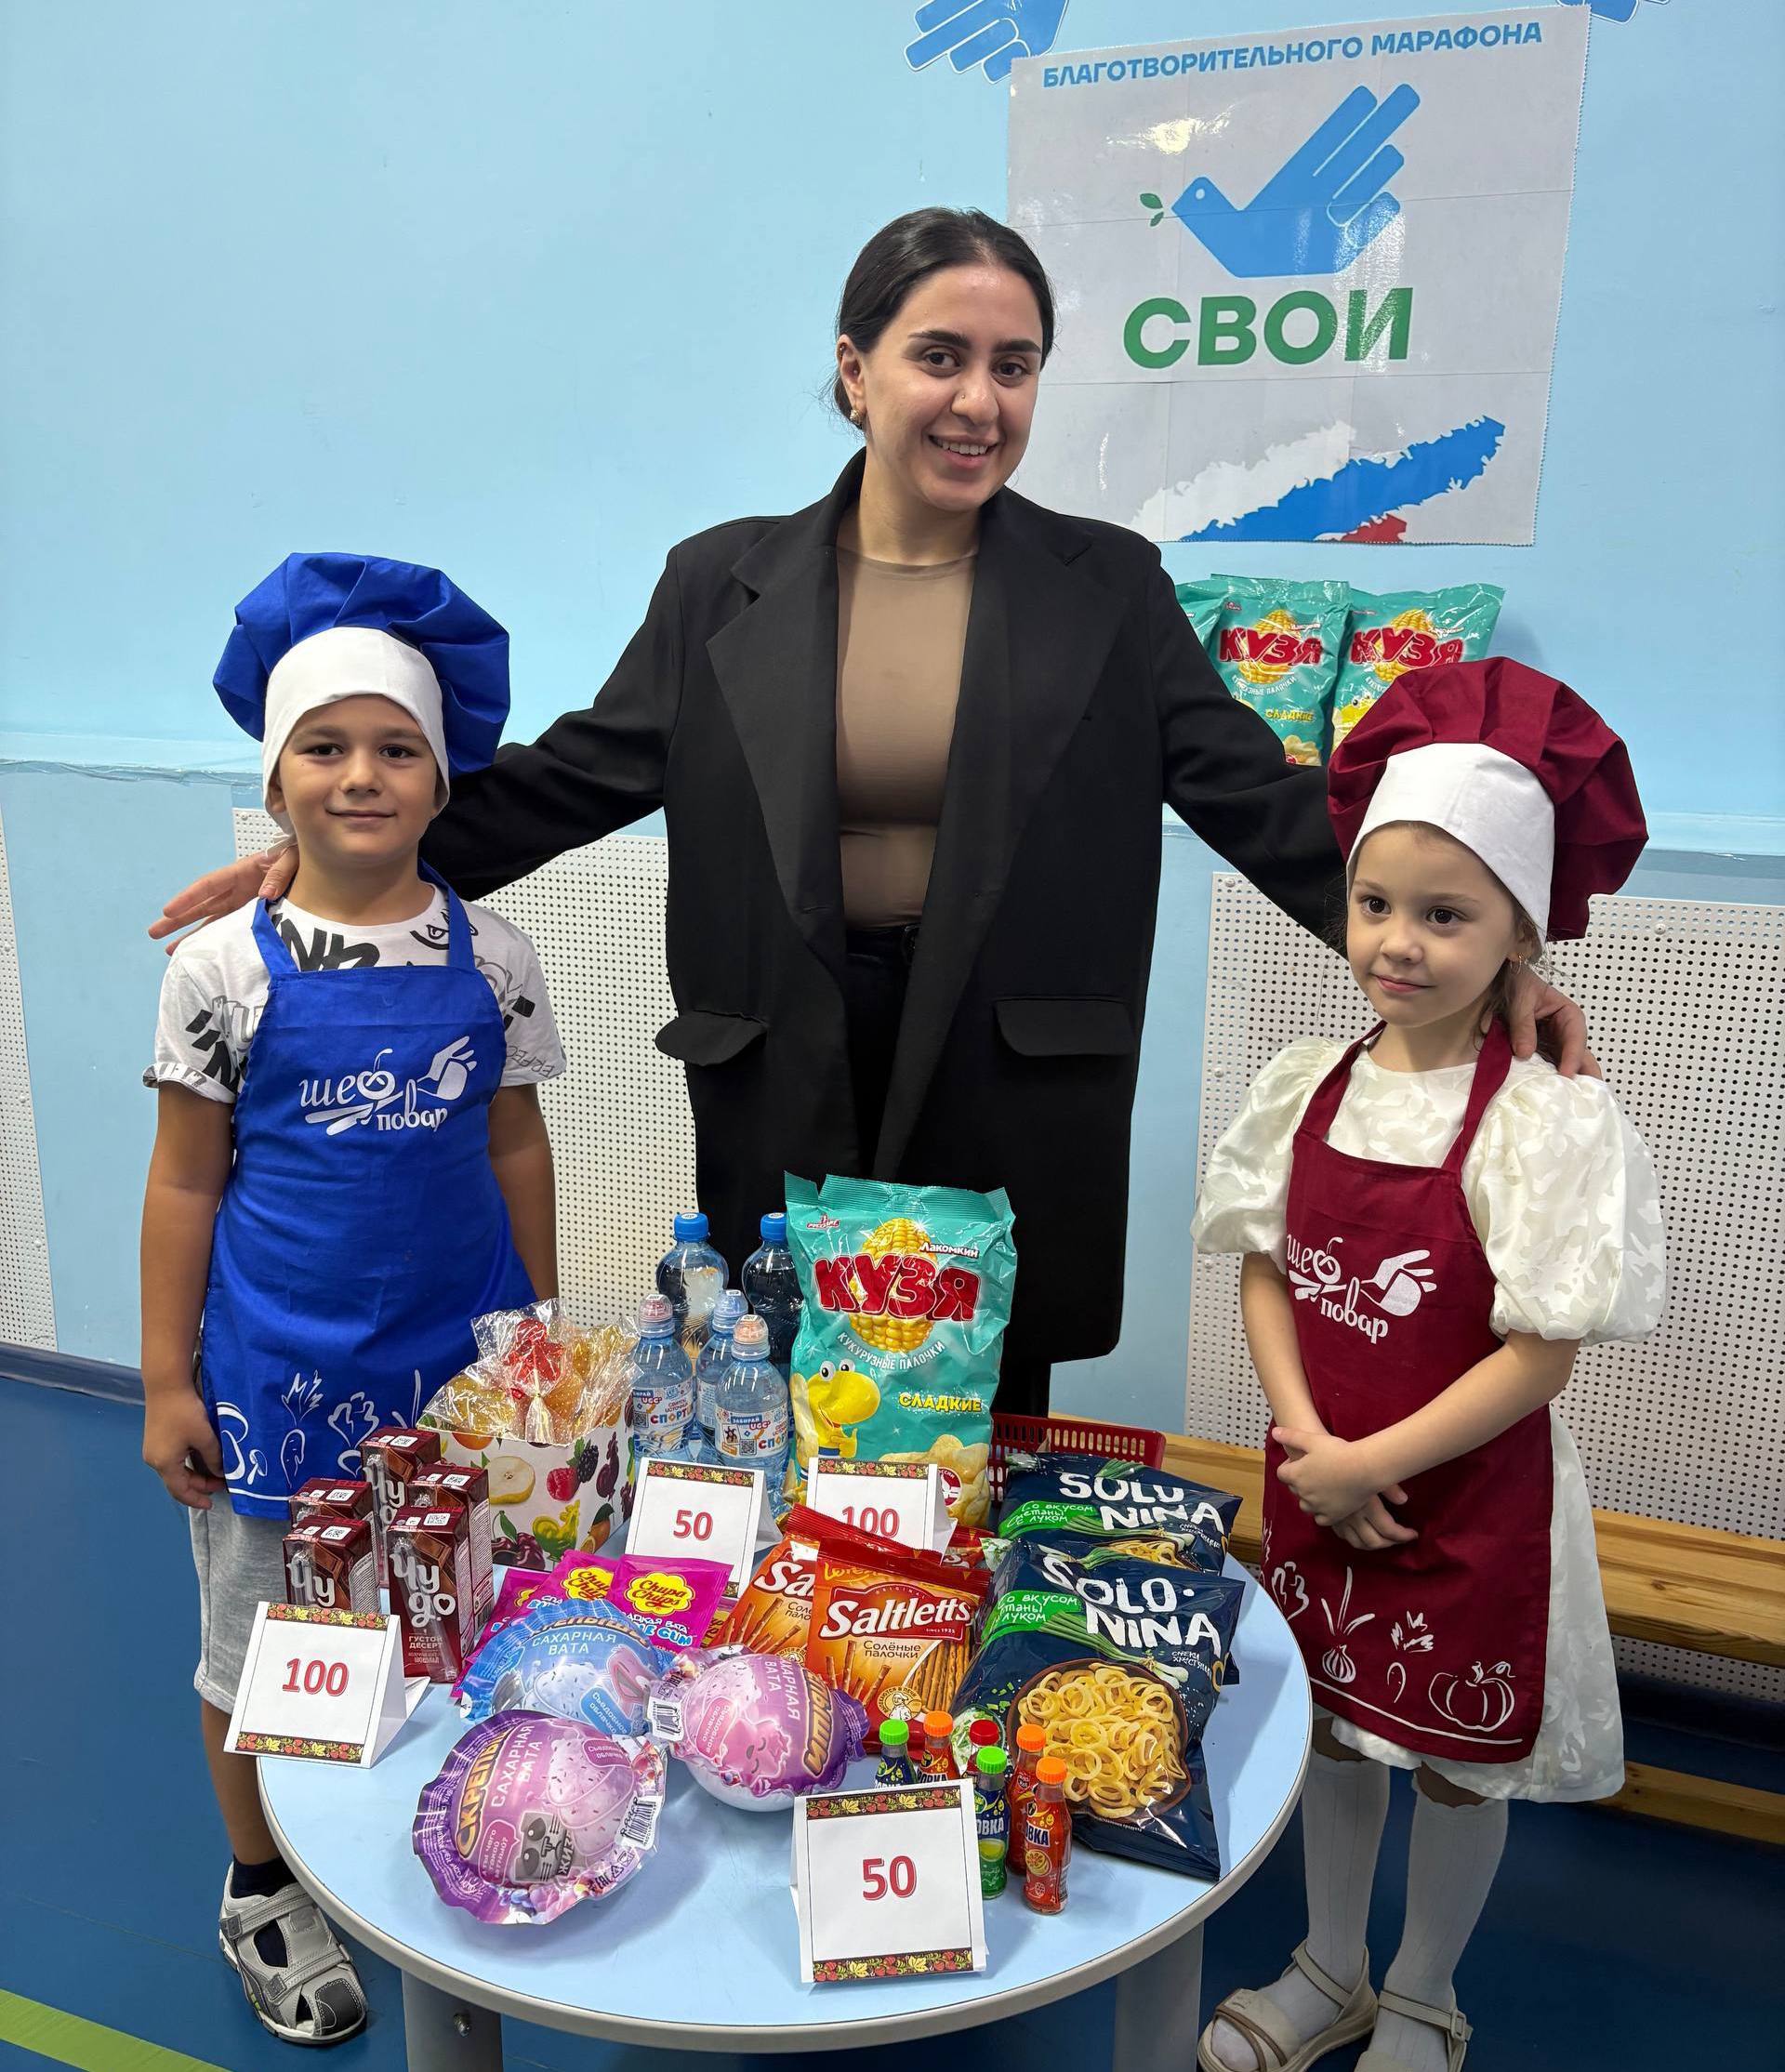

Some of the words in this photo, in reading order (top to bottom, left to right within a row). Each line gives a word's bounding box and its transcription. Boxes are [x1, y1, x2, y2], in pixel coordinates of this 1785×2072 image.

[1042, 37, 1364, 88] БЛАГОТВОРИТЕЛЬНОГО
[1370, 21, 1542, 58] МАРАФОНА
[1122, 286, 1414, 369] СВОИ
[1219, 627, 1323, 667] КУЗЯ
[506, 1045, 555, 1077] ERFEC
[377, 1078, 448, 1133] повар
[919, 1241, 980, 1260] Лакомкин
[813, 1253, 982, 1323] КУЗЯ
[1321, 1277, 1389, 1344] повар
[837, 1331, 896, 1371] КУКУРУЗНЫЕ
[898, 1340, 946, 1371] ПАЛОЧКИ
[898, 1392, 983, 1413] СЛАДКИЕ
[673, 1509, 714, 1541] 50
[840, 1505, 901, 1538] 100
[1099, 1501, 1225, 1533] NINA
[631, 1588, 681, 1610] Chups
[642, 1579, 685, 1598] Chupa
[665, 1620, 688, 1634] ВАТА
[784, 1609, 812, 1621] пало
[819, 1596, 972, 1639] Saltletts
[1085, 1599, 1222, 1659] NINA
[533, 1631, 617, 1647] САХАРНАЯ
[549, 1643, 589, 1656] ВАТА
[656, 1627, 694, 1646] GUM
[863, 1640, 921, 1652] Солёные
[864, 1649, 919, 1659] палочки
[282, 1657, 350, 1696] 100
[764, 1660, 782, 1692] ВАТА
[491, 1725, 536, 1808] САХАРНАЯ
[517, 1740, 543, 1784] ВАТА
[558, 1831, 574, 1876] ЖИЗ
[861, 1854, 917, 1901] 50
